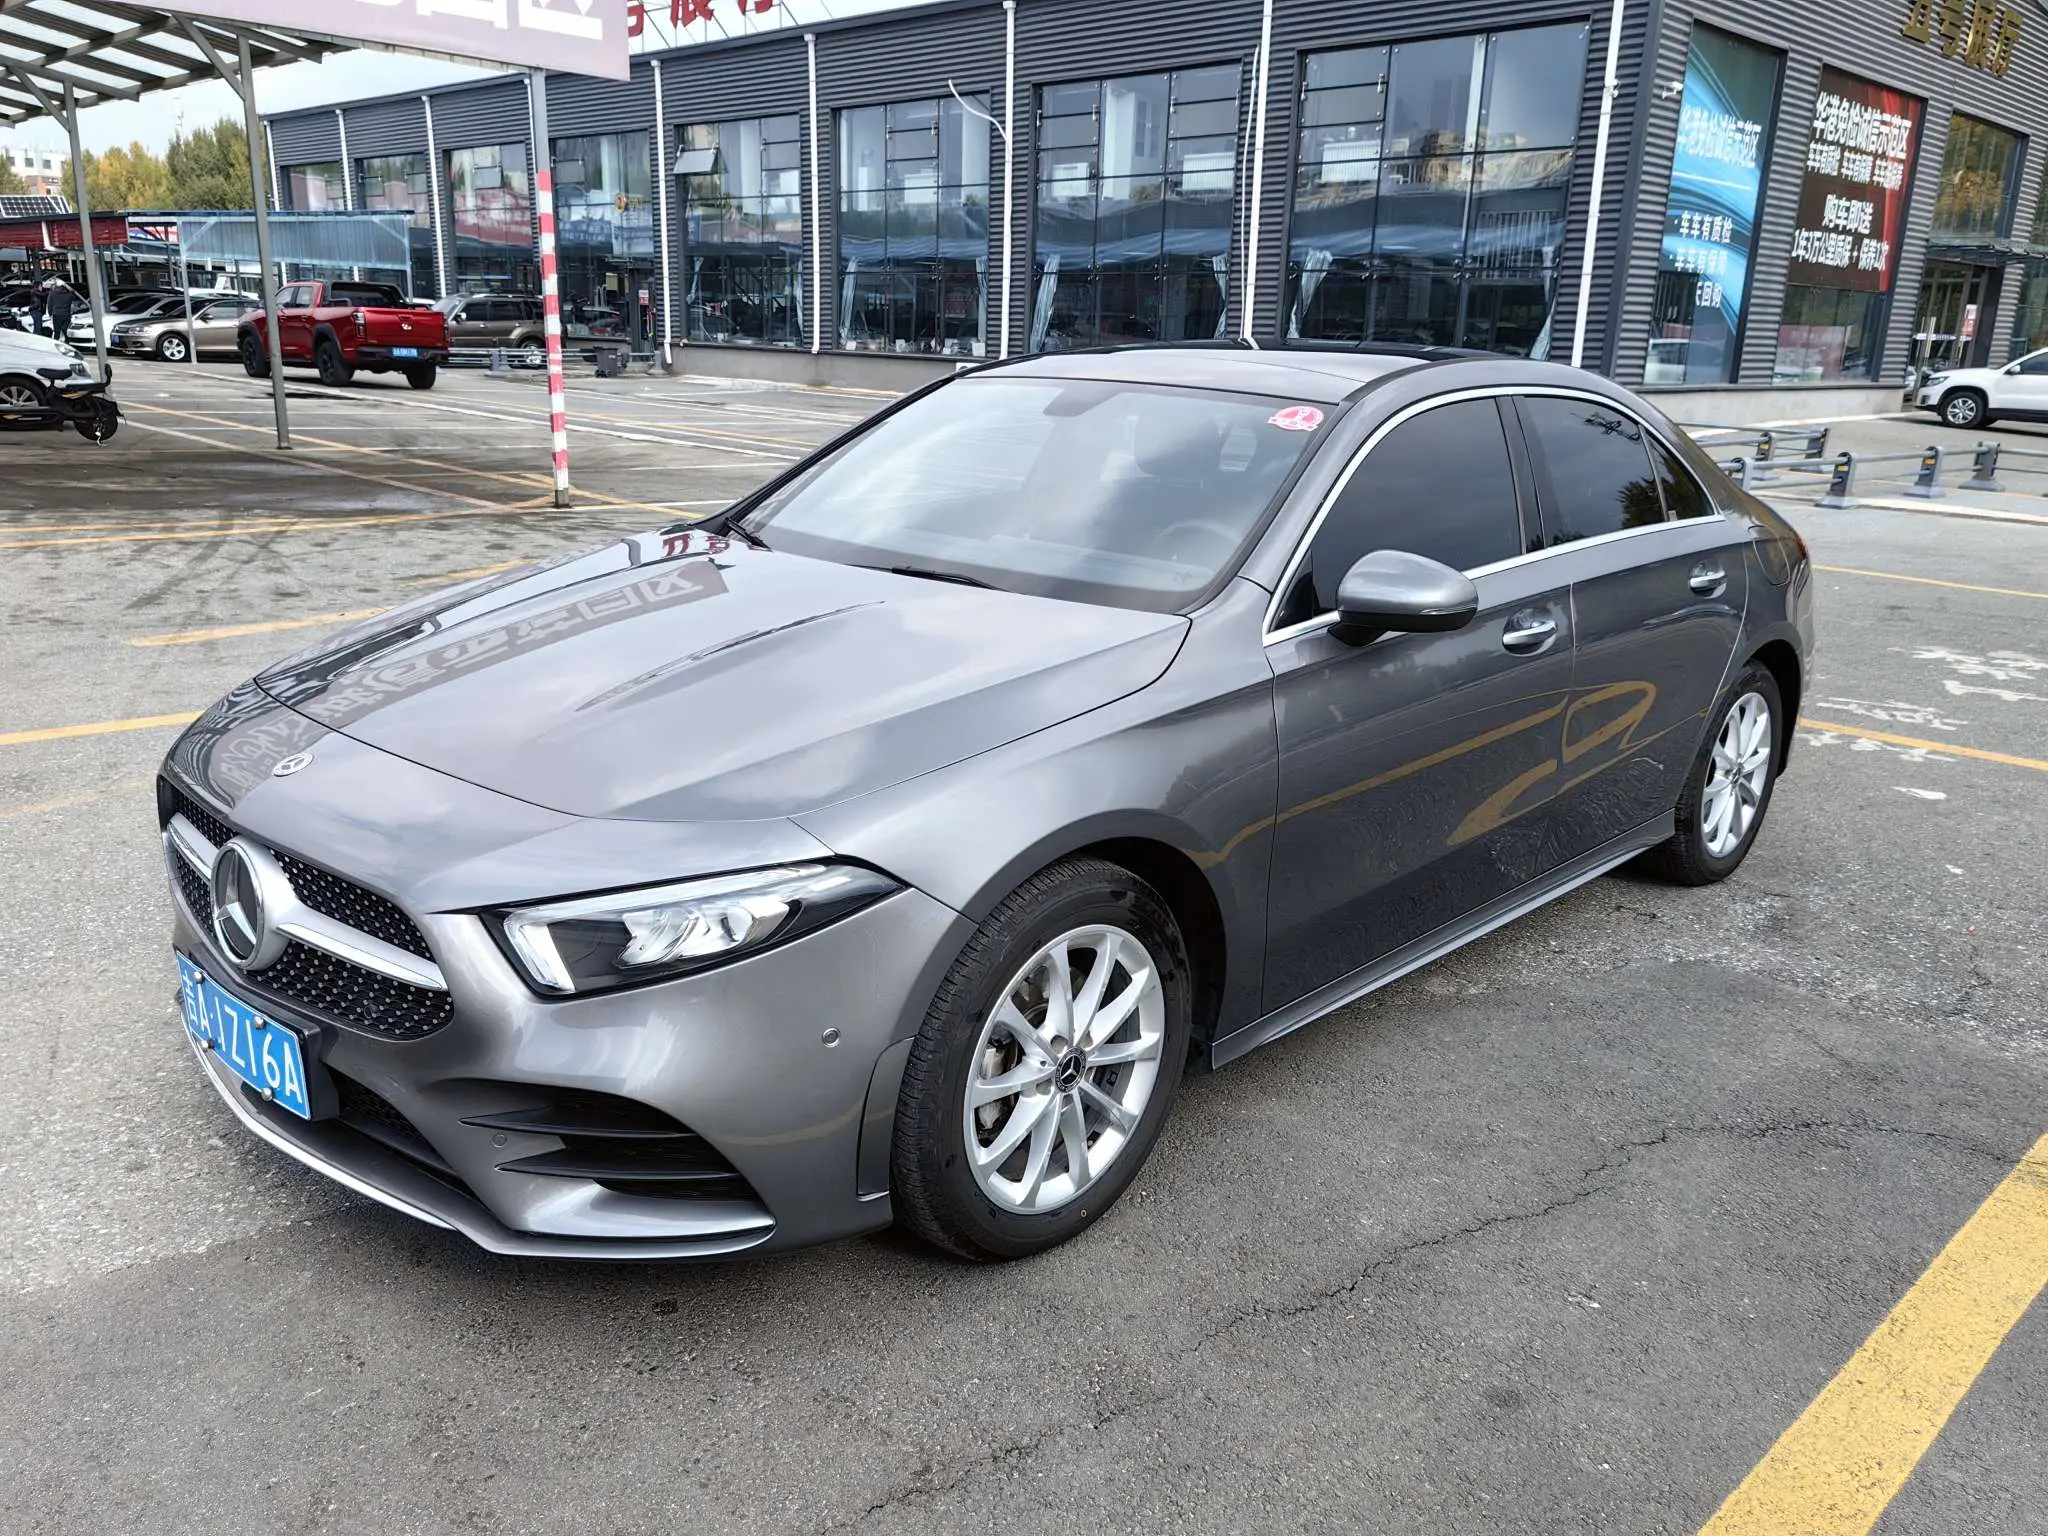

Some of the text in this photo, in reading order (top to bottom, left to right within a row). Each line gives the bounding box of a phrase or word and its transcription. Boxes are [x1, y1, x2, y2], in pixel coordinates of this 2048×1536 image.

[1679, 211, 1733, 243] 车车有质检
[1822, 194, 1874, 234] 购车即送
